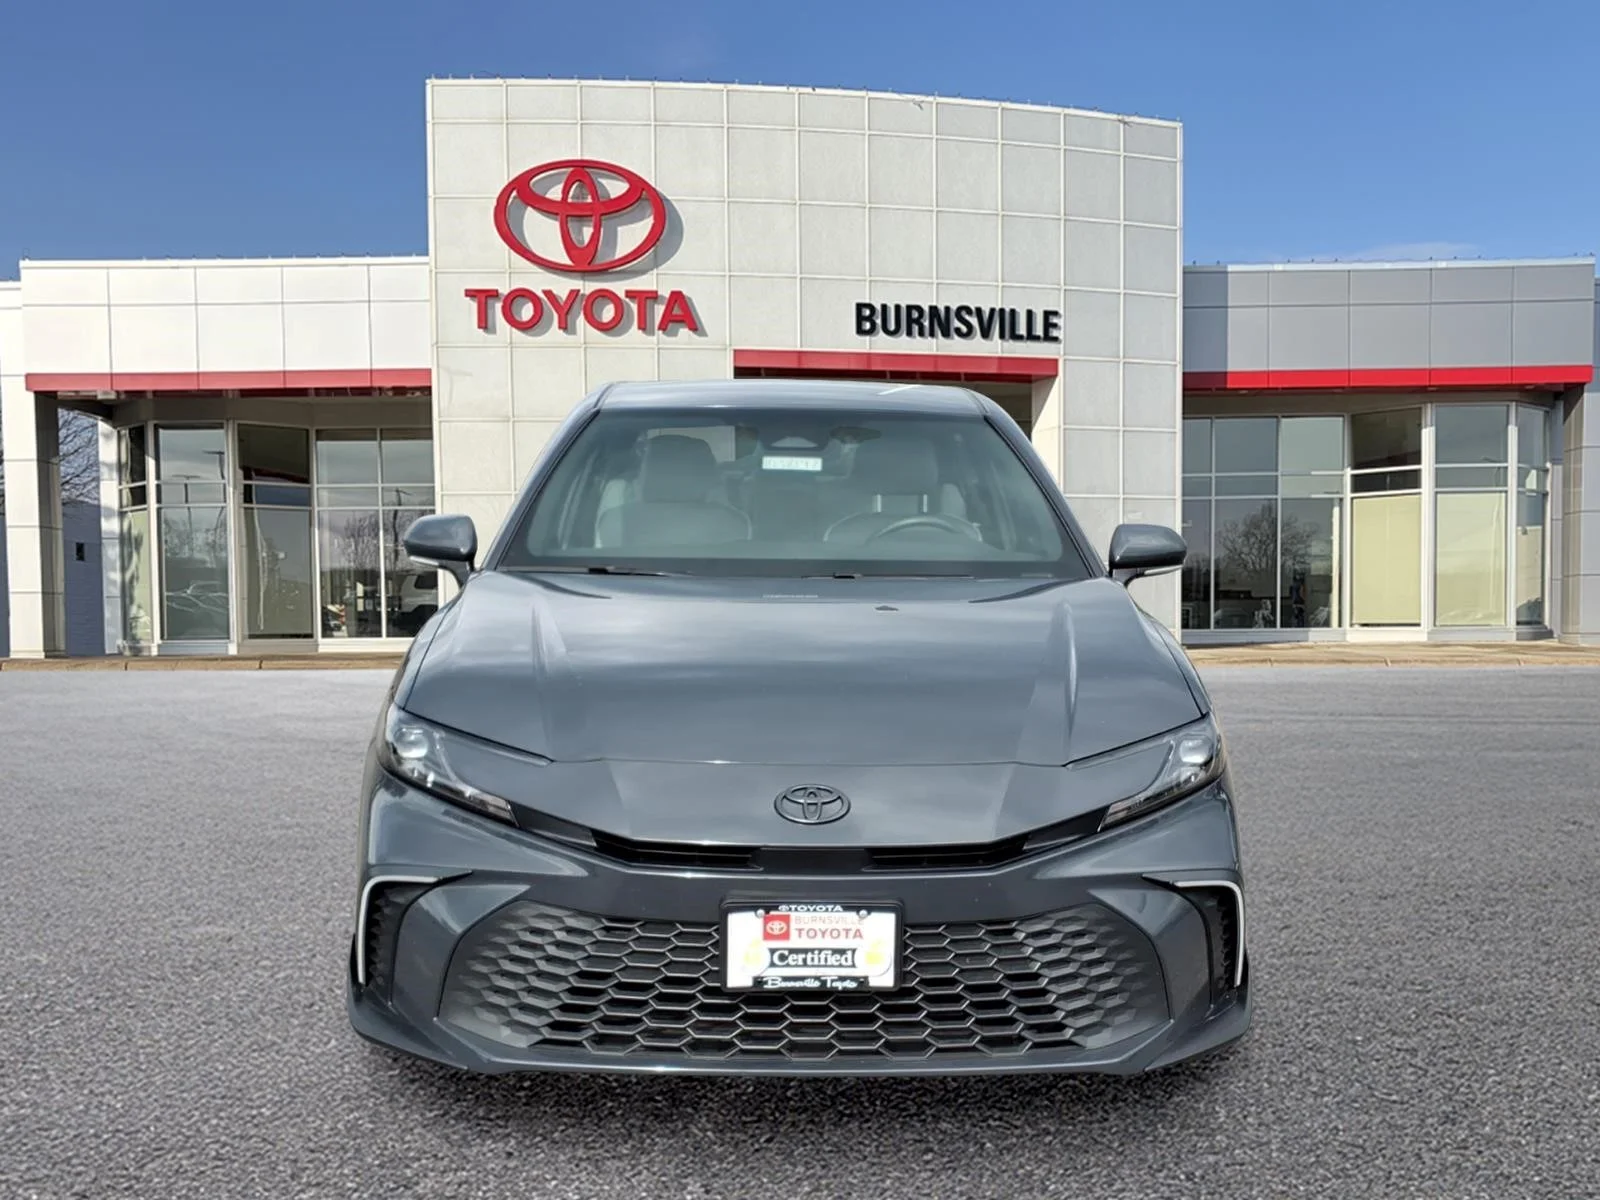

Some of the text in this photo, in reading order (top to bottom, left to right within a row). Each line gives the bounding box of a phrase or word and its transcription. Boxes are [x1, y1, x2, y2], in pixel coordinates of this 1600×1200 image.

[464, 287, 699, 332] TOYOTA
[855, 302, 1061, 342] BURNSVILLE
[789, 904, 844, 912] TOYOTA
[794, 915, 865, 925] BURNSVILLE
[795, 927, 864, 940] TOYOTA
[772, 950, 853, 966] Certified
